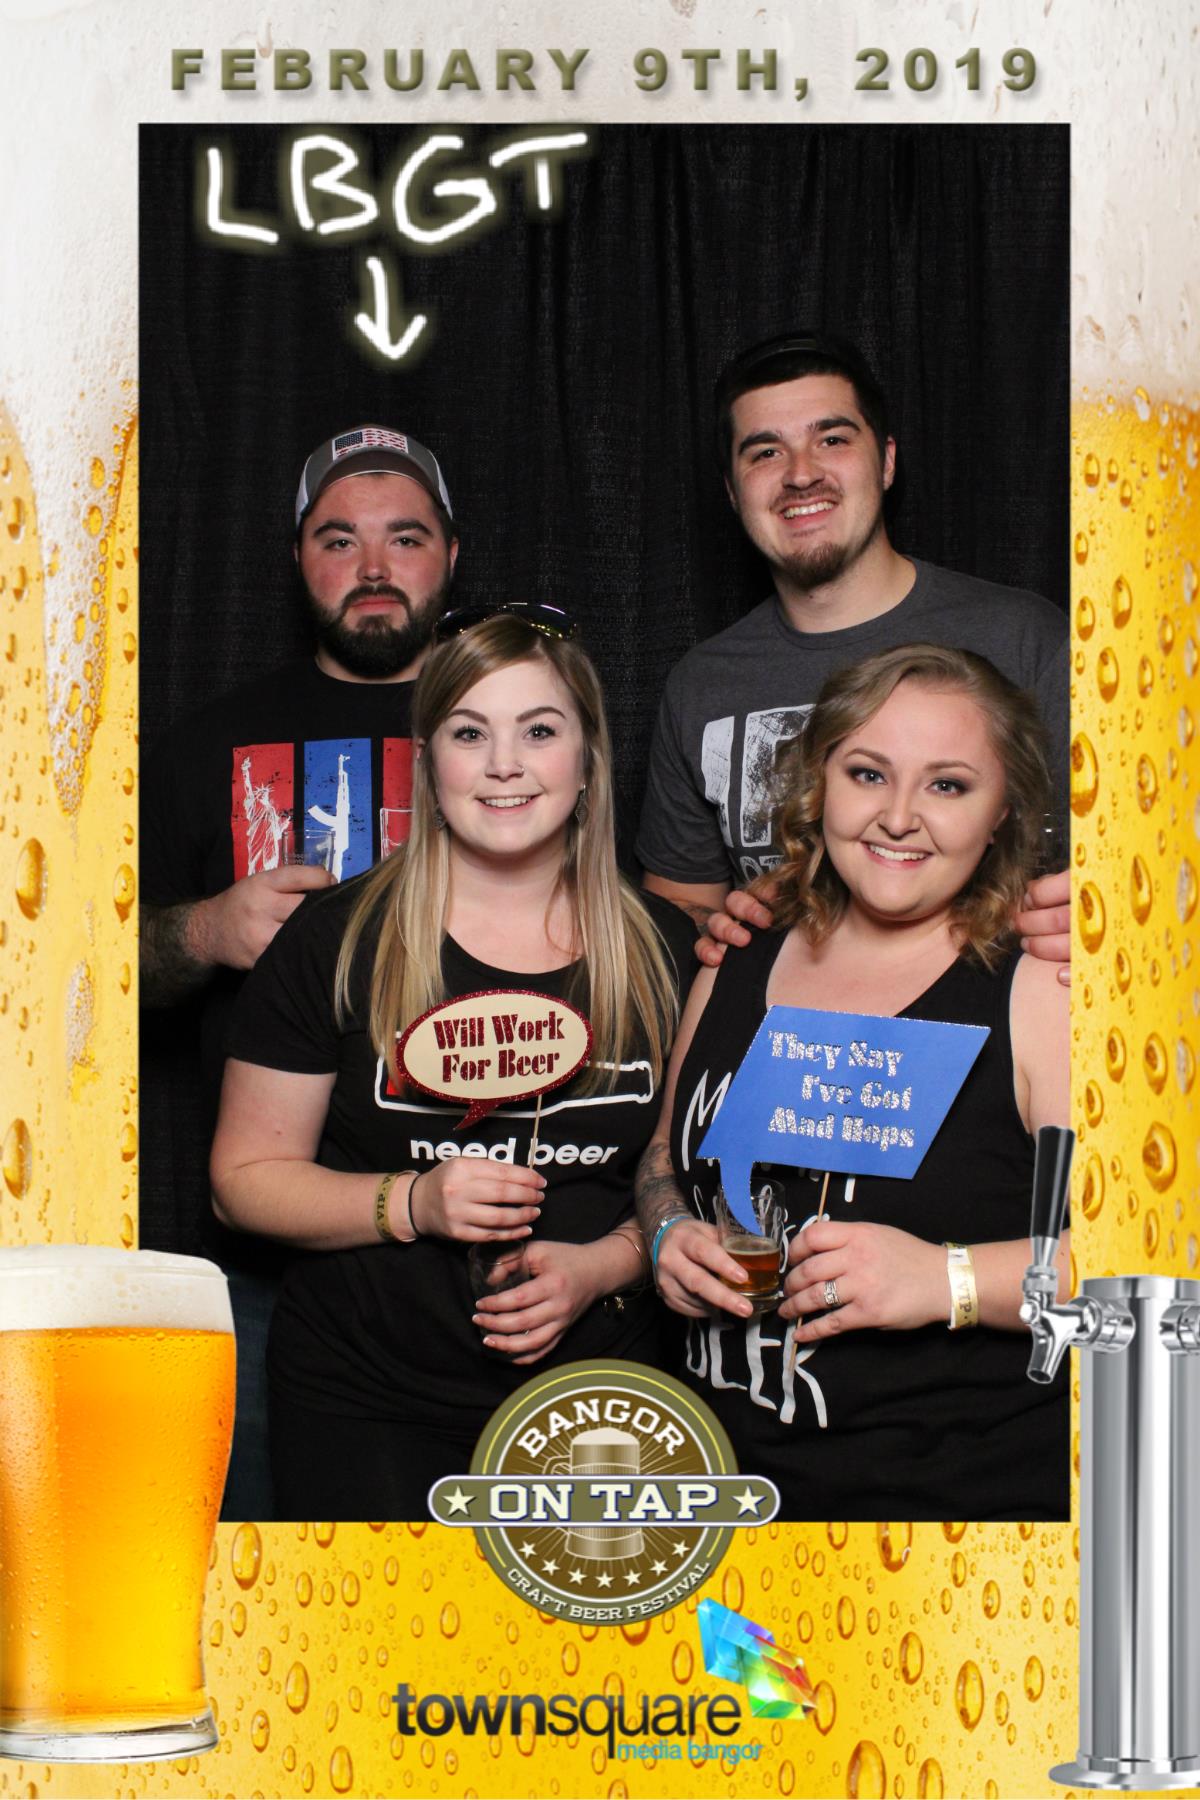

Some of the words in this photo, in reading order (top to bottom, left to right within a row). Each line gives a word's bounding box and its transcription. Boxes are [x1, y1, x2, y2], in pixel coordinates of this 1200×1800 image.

[433, 1016, 485, 1050] Will
[491, 1011, 565, 1045] Work
[442, 1053, 491, 1083] For
[498, 1050, 561, 1079] Beer
[768, 1030, 843, 1070] They
[848, 1040, 904, 1077] Say
[802, 1073, 853, 1104] I've
[860, 1081, 913, 1111] Got
[768, 1106, 836, 1140] Mad
[841, 1115, 915, 1152] Hops
[410, 1137, 517, 1165] need
[527, 1138, 619, 1166] beer
